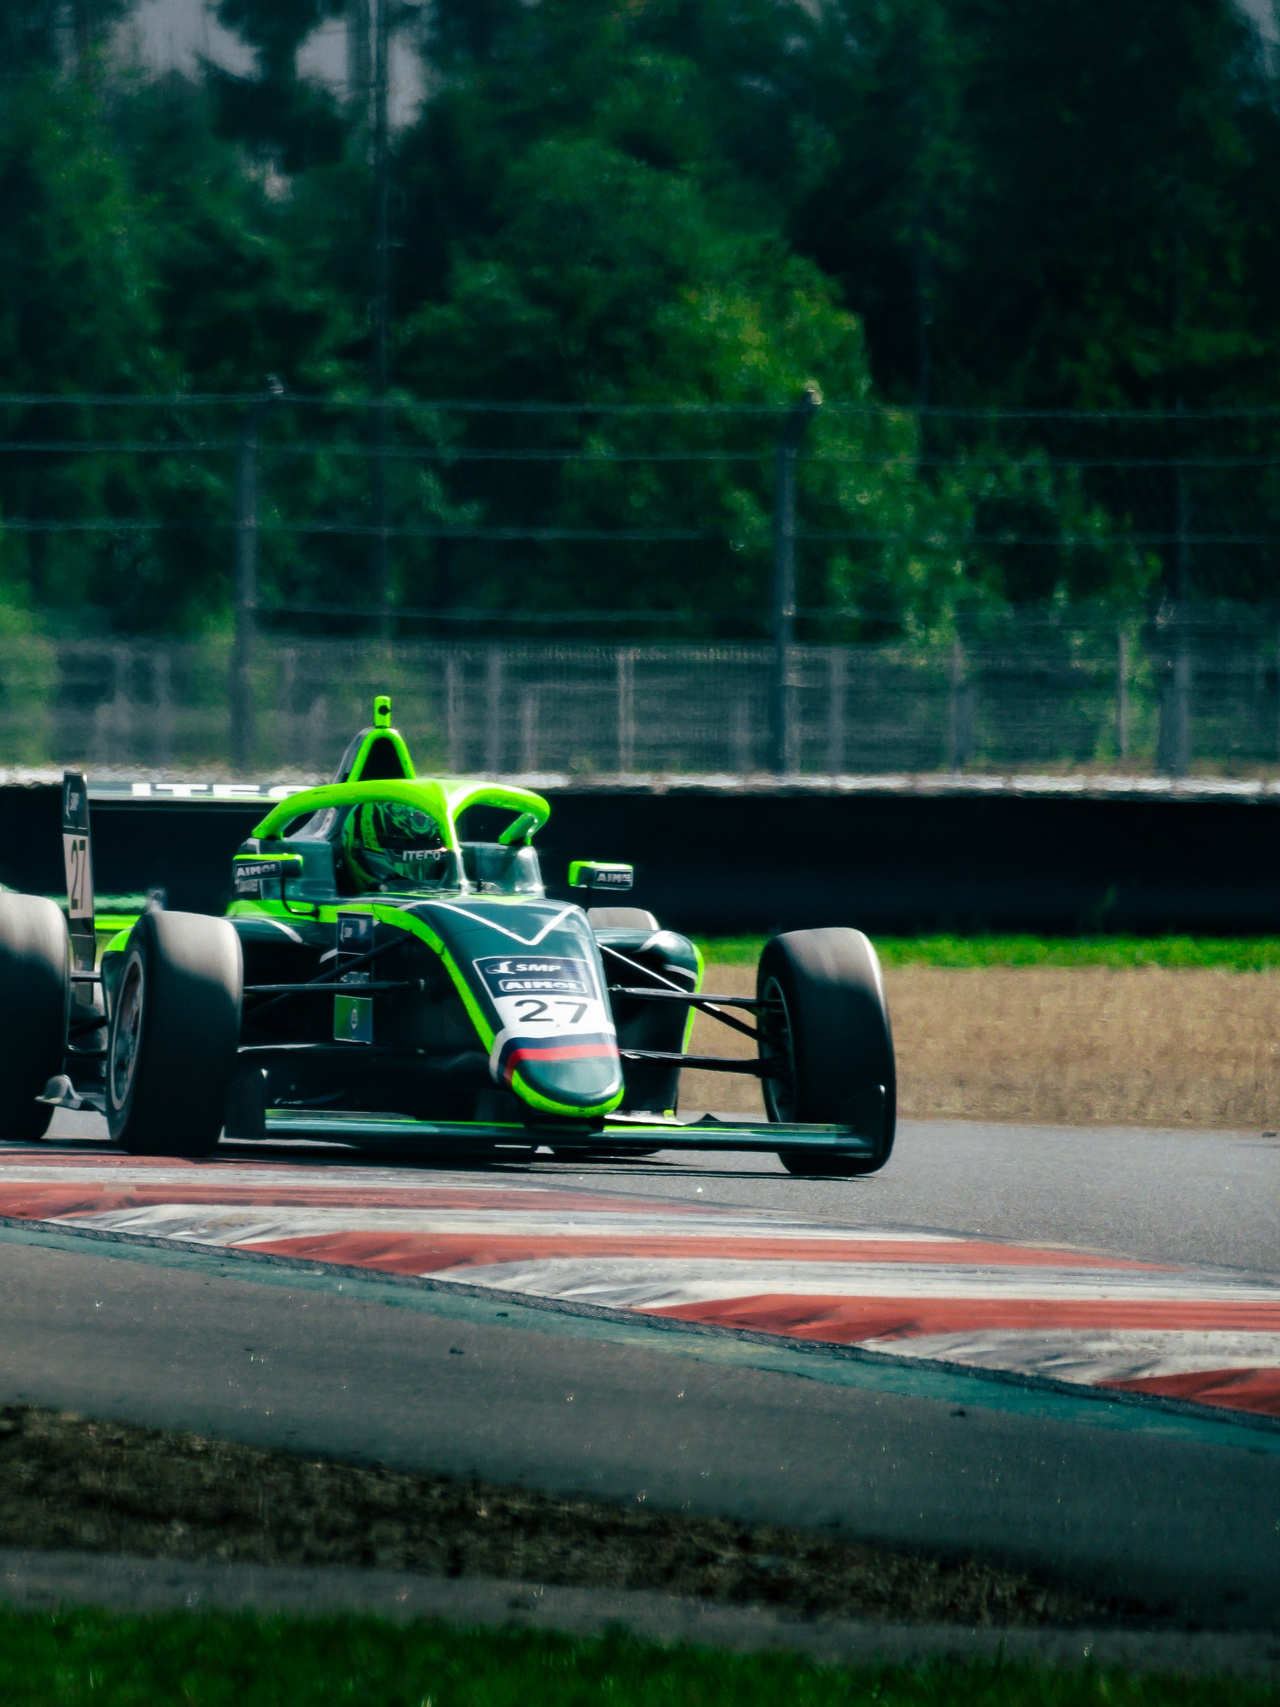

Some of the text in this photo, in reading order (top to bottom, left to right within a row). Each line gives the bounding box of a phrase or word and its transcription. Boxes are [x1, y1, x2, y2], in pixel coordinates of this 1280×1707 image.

[70, 839, 86, 910] 27
[515, 963, 562, 973] SMP
[505, 980, 580, 990] AIMOL
[514, 1000, 589, 1025] 27
